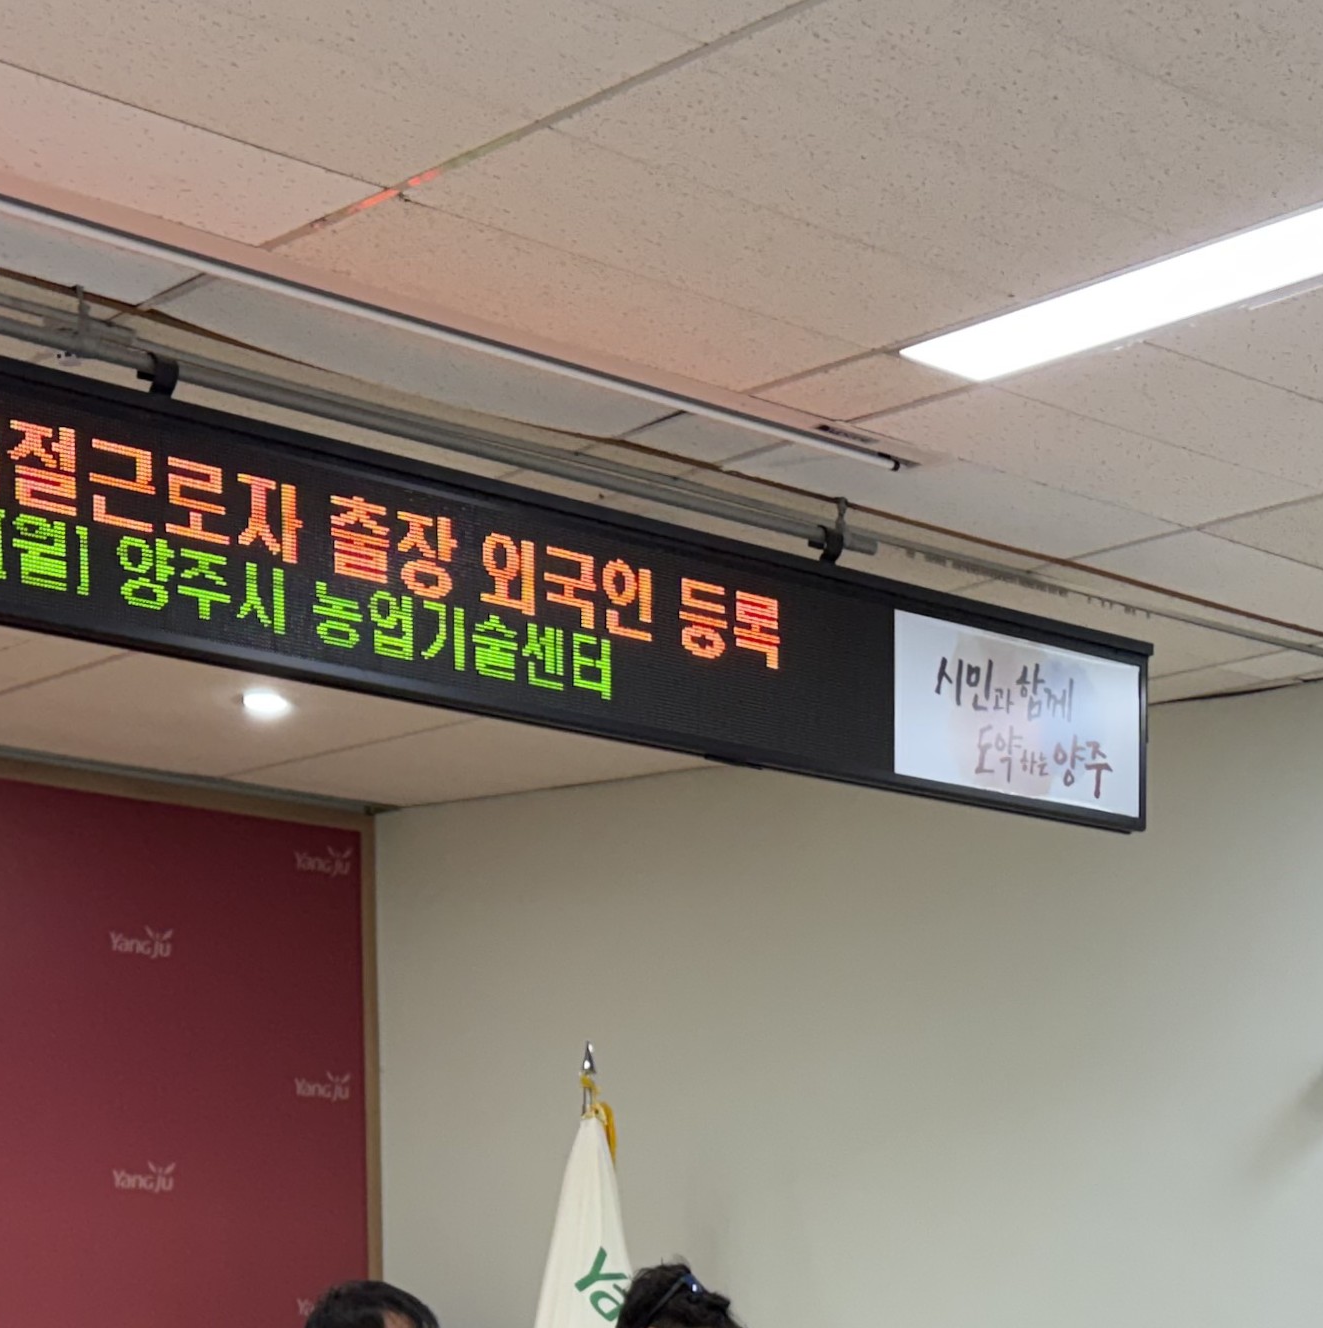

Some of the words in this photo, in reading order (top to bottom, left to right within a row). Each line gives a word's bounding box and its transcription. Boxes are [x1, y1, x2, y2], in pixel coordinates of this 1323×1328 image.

[329, 495, 458, 599] 출장
[479, 531, 652, 642] 외국인
[679, 577, 781, 670] 등록
[116, 535, 286, 634] 양주시
[312, 578, 613, 700] 농업기술센터
[935, 656, 1014, 714] 시민과
[1016, 663, 1074, 722] 함께
[975, 725, 1049, 783] 도약하는
[1053, 735, 1113, 799] 양주
[110, 931, 172, 960] Yangju
[294, 1076, 349, 1103] Yangju
[113, 1167, 174, 1194] Yangju
